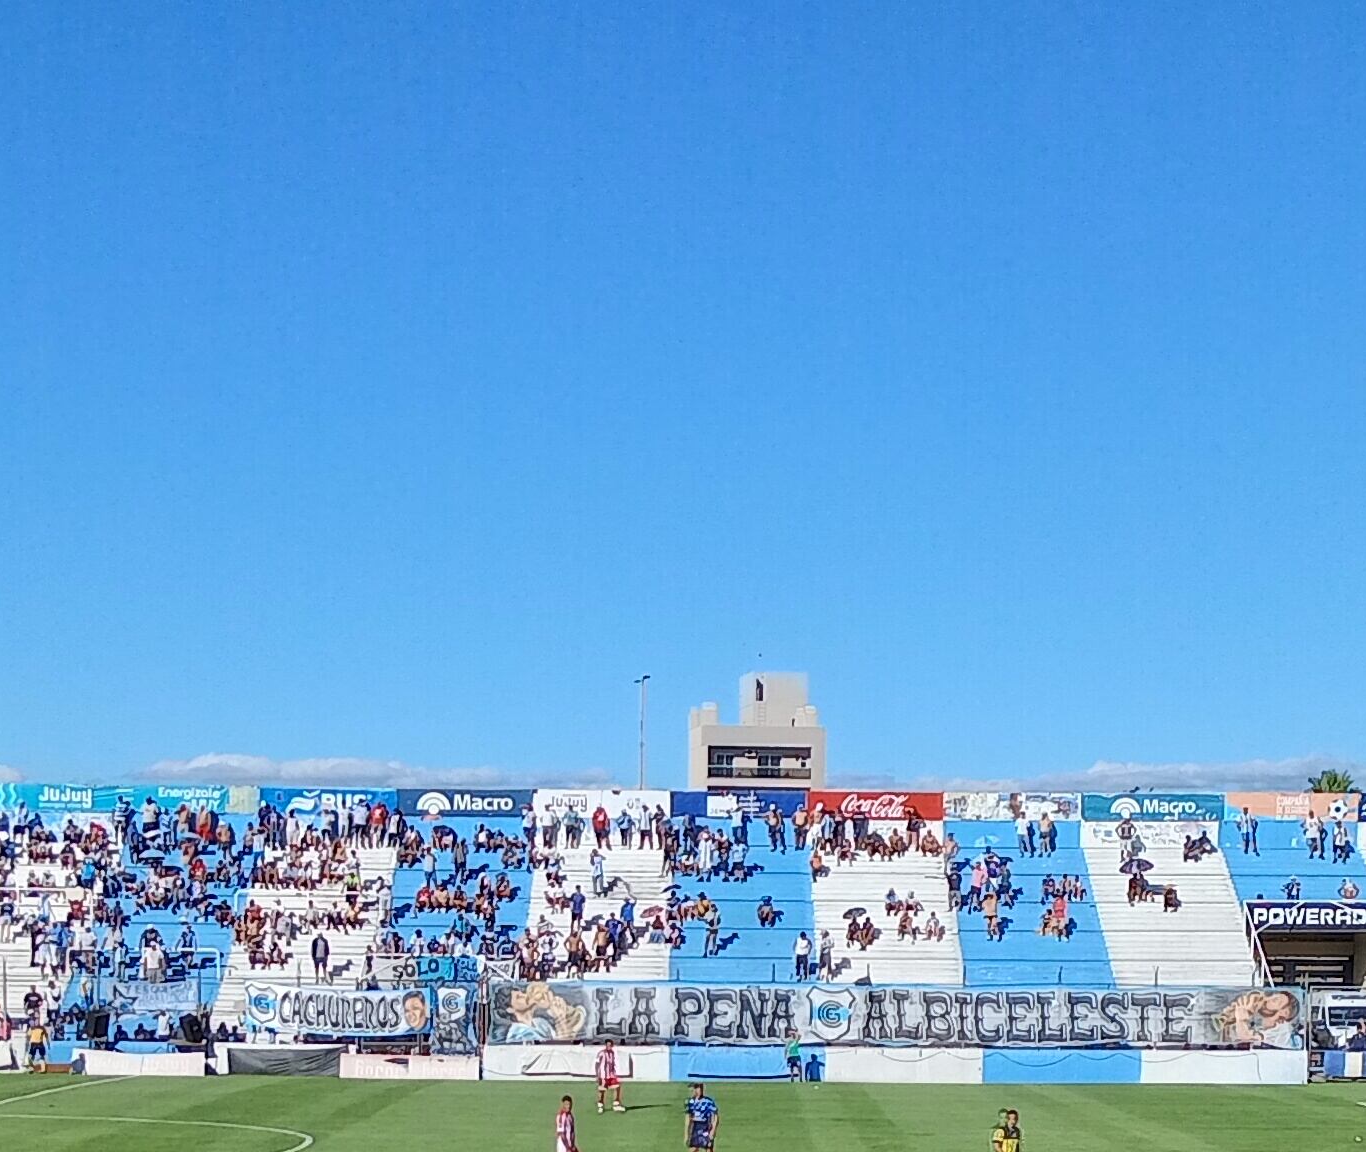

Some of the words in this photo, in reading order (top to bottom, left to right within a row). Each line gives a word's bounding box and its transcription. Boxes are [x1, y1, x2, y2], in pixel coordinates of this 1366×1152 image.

[453, 794, 514, 811] Macro
[1142, 798, 1196, 814] Macro
[594, 987, 661, 1037] LA
[863, 988, 1194, 1043] ALBICELESTE
